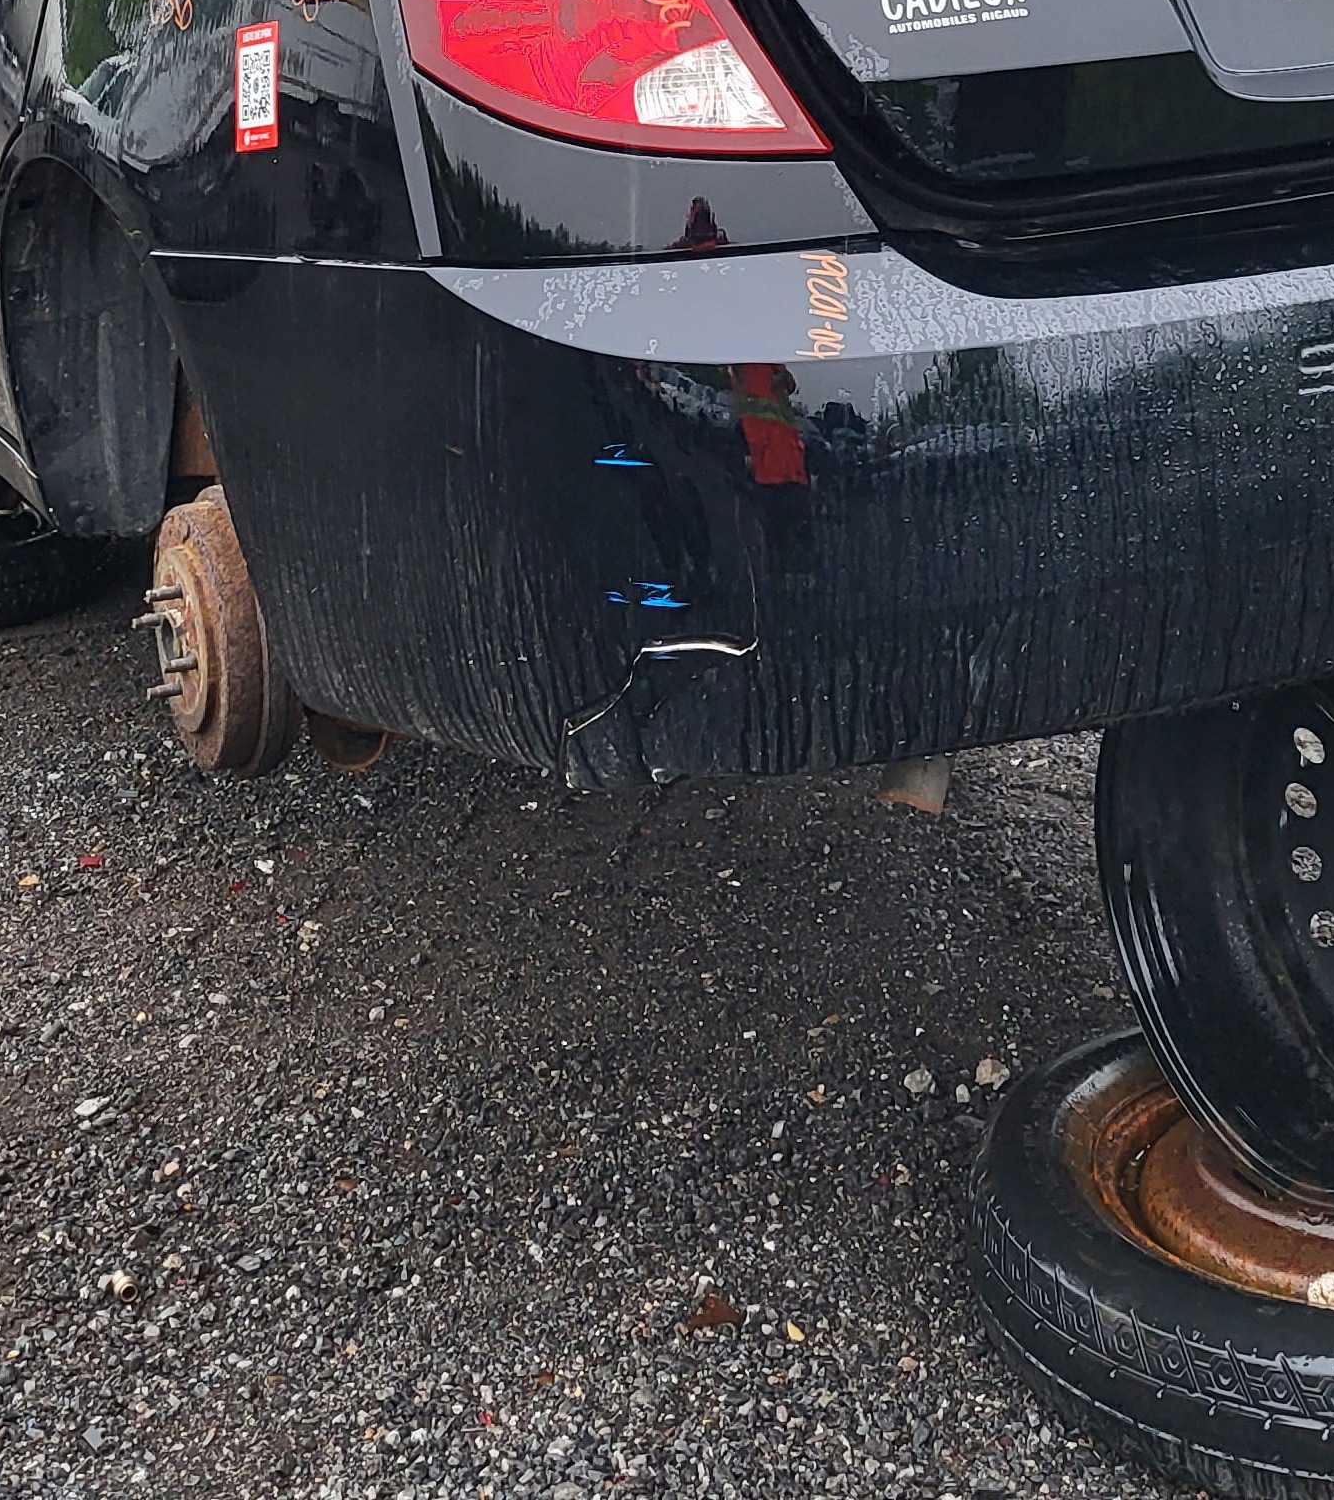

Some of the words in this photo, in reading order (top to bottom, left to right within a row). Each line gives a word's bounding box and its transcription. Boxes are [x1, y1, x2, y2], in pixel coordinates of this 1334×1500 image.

[888, 13, 978, 35] AUTOMOBILES
[980, 8, 1030, 22] RIGAUD
[795, 253, 849, 359] 19201-04
